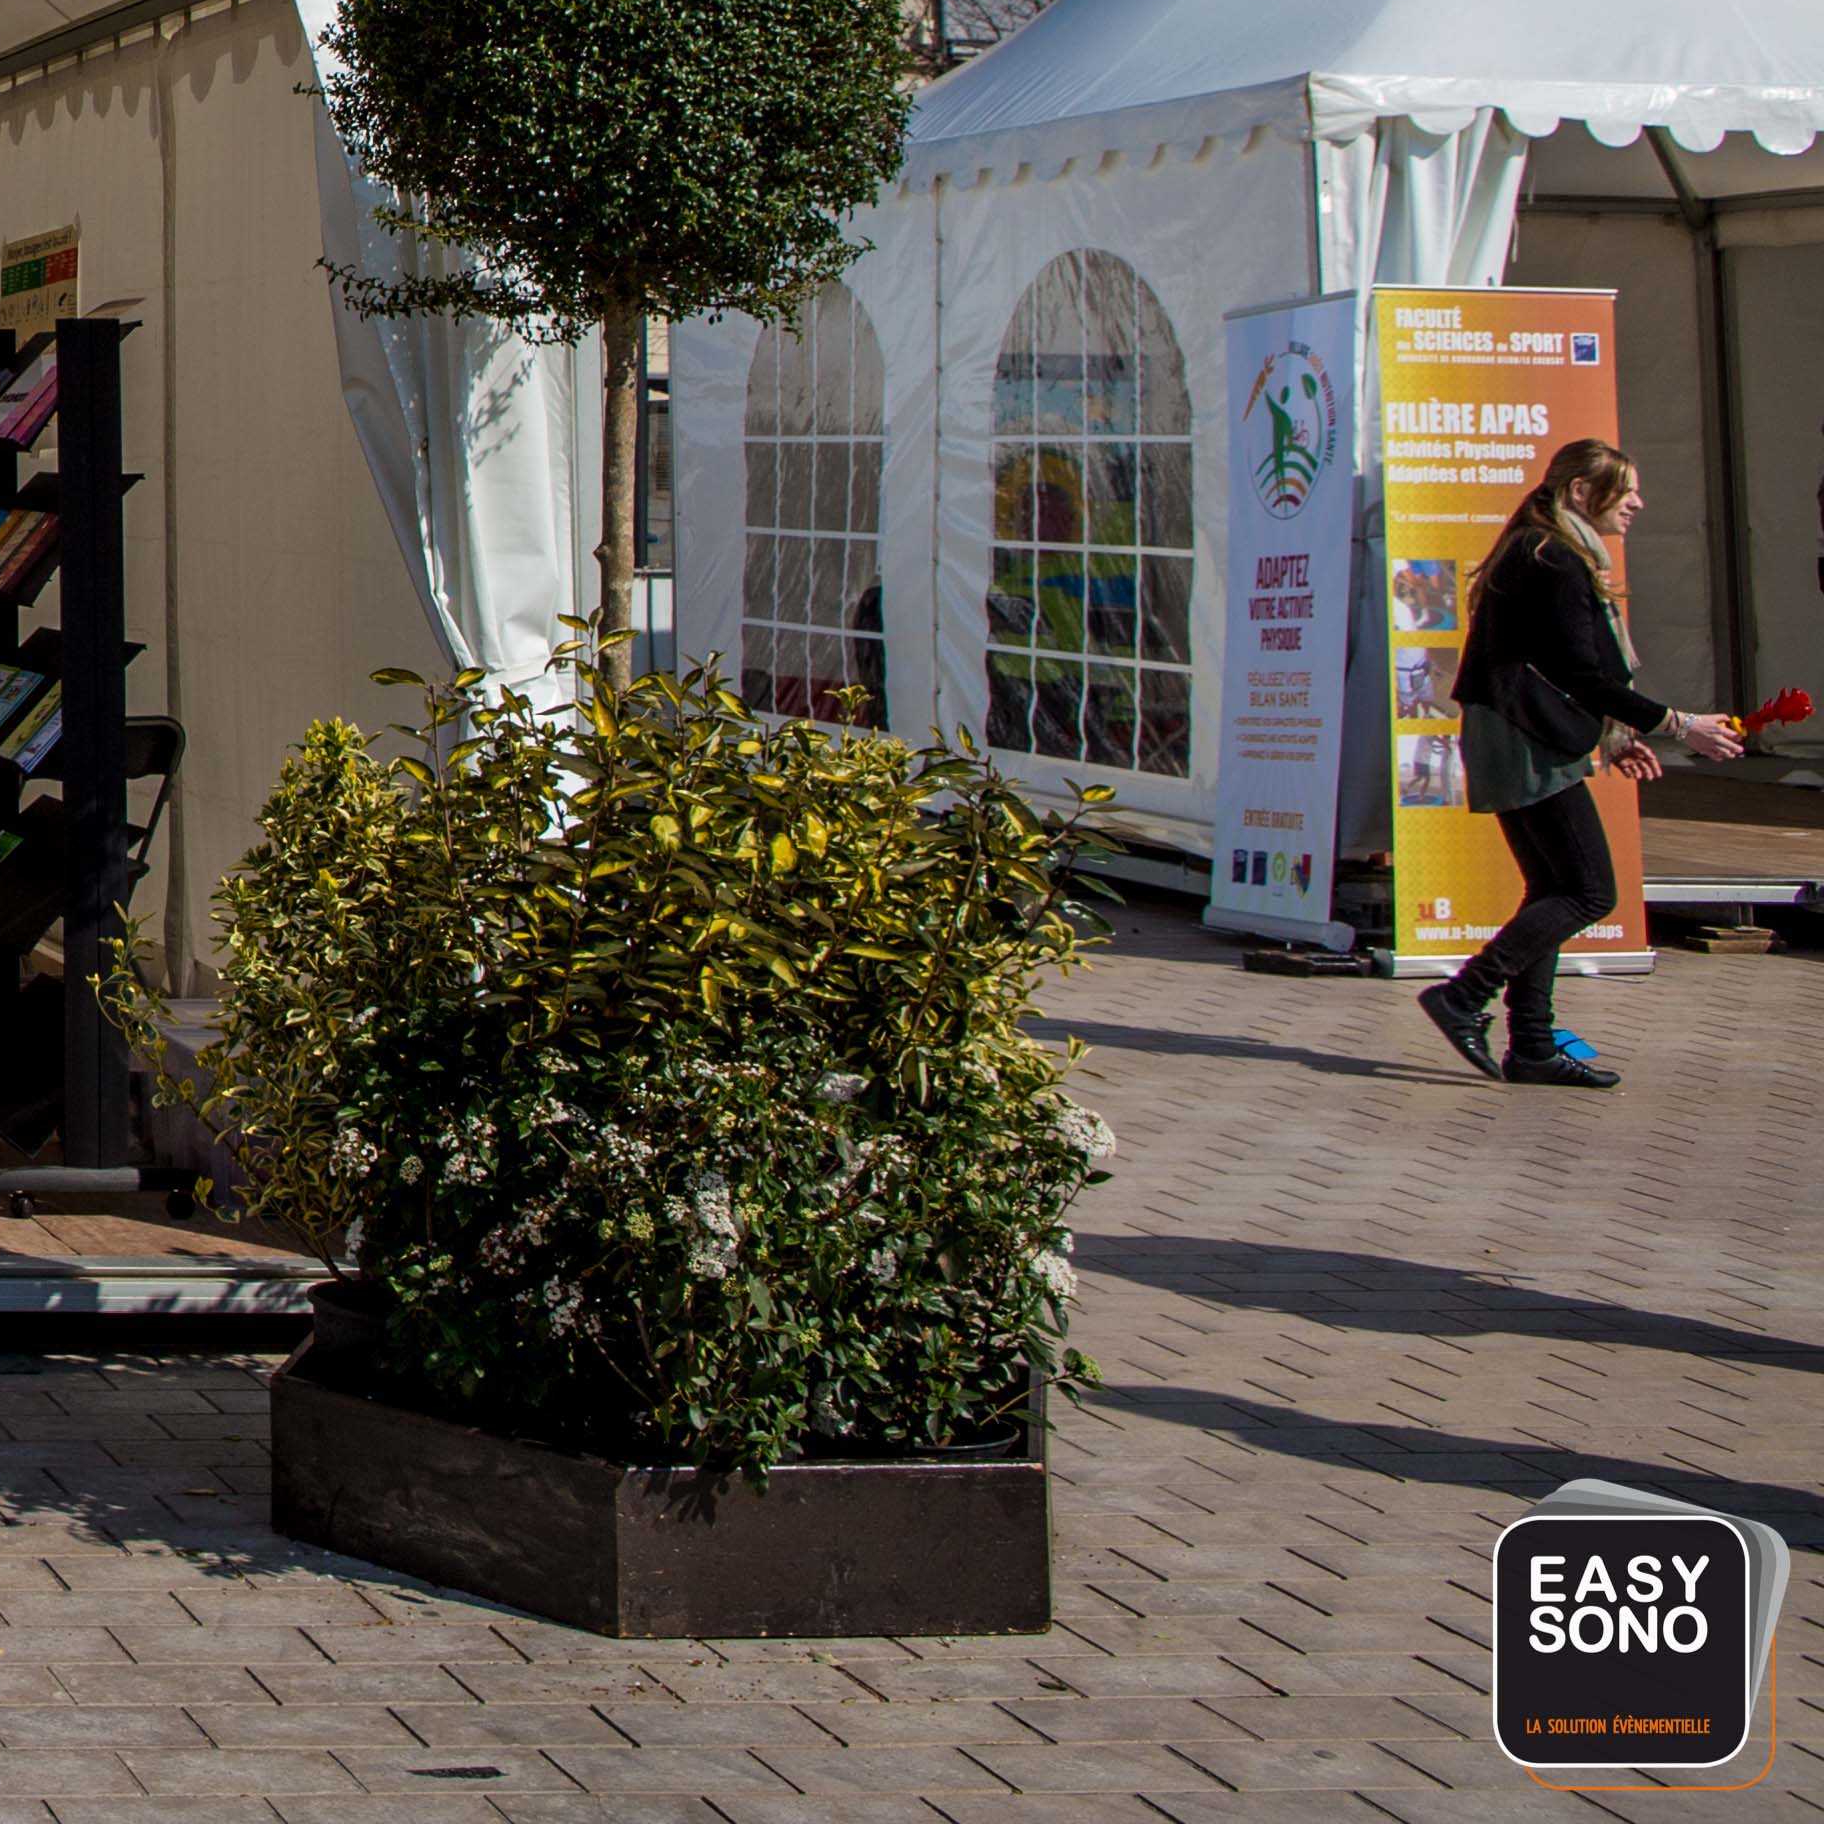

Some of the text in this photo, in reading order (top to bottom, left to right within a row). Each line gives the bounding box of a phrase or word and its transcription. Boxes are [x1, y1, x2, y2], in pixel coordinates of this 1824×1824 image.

[1394, 306, 1462, 329] FACULTÉ
[1414, 331, 1493, 353] SCIENCES
[1510, 332, 1564, 353] SPORT
[1385, 396, 1550, 435] FILIÈRE APAS
[1455, 440, 1536, 461] Physiques
[1461, 466, 1477, 483] et
[1479, 465, 1524, 483] Santé
[1256, 554, 1309, 590] ADAPTEZ
[1249, 689, 1309, 707] BILAN SANTÉ
[1417, 897, 1451, 919] uB
